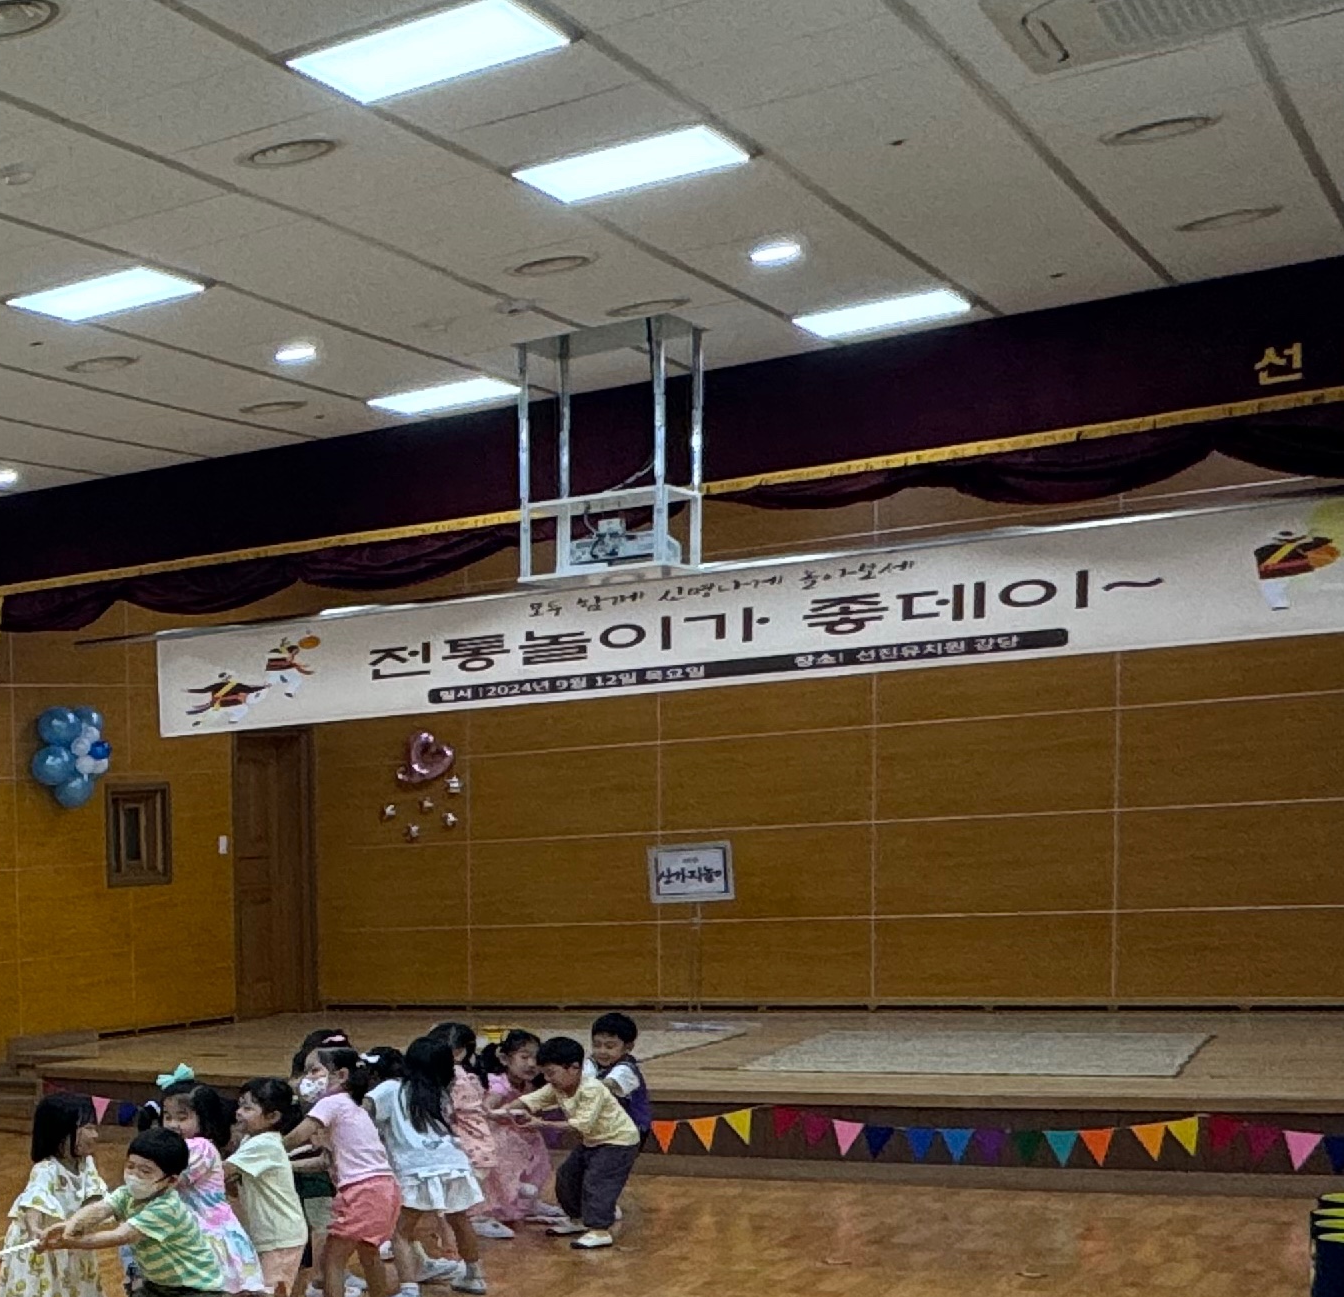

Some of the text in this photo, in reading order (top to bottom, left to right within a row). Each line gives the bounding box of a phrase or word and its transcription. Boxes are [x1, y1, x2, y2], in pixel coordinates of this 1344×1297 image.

[1254, 342, 1303, 386] 선
[368, 606, 771, 681] 전통놀이가
[439, 634, 1019, 702] 일시 2024년 9월 12일 목요일 장소 선진유치원 강당
